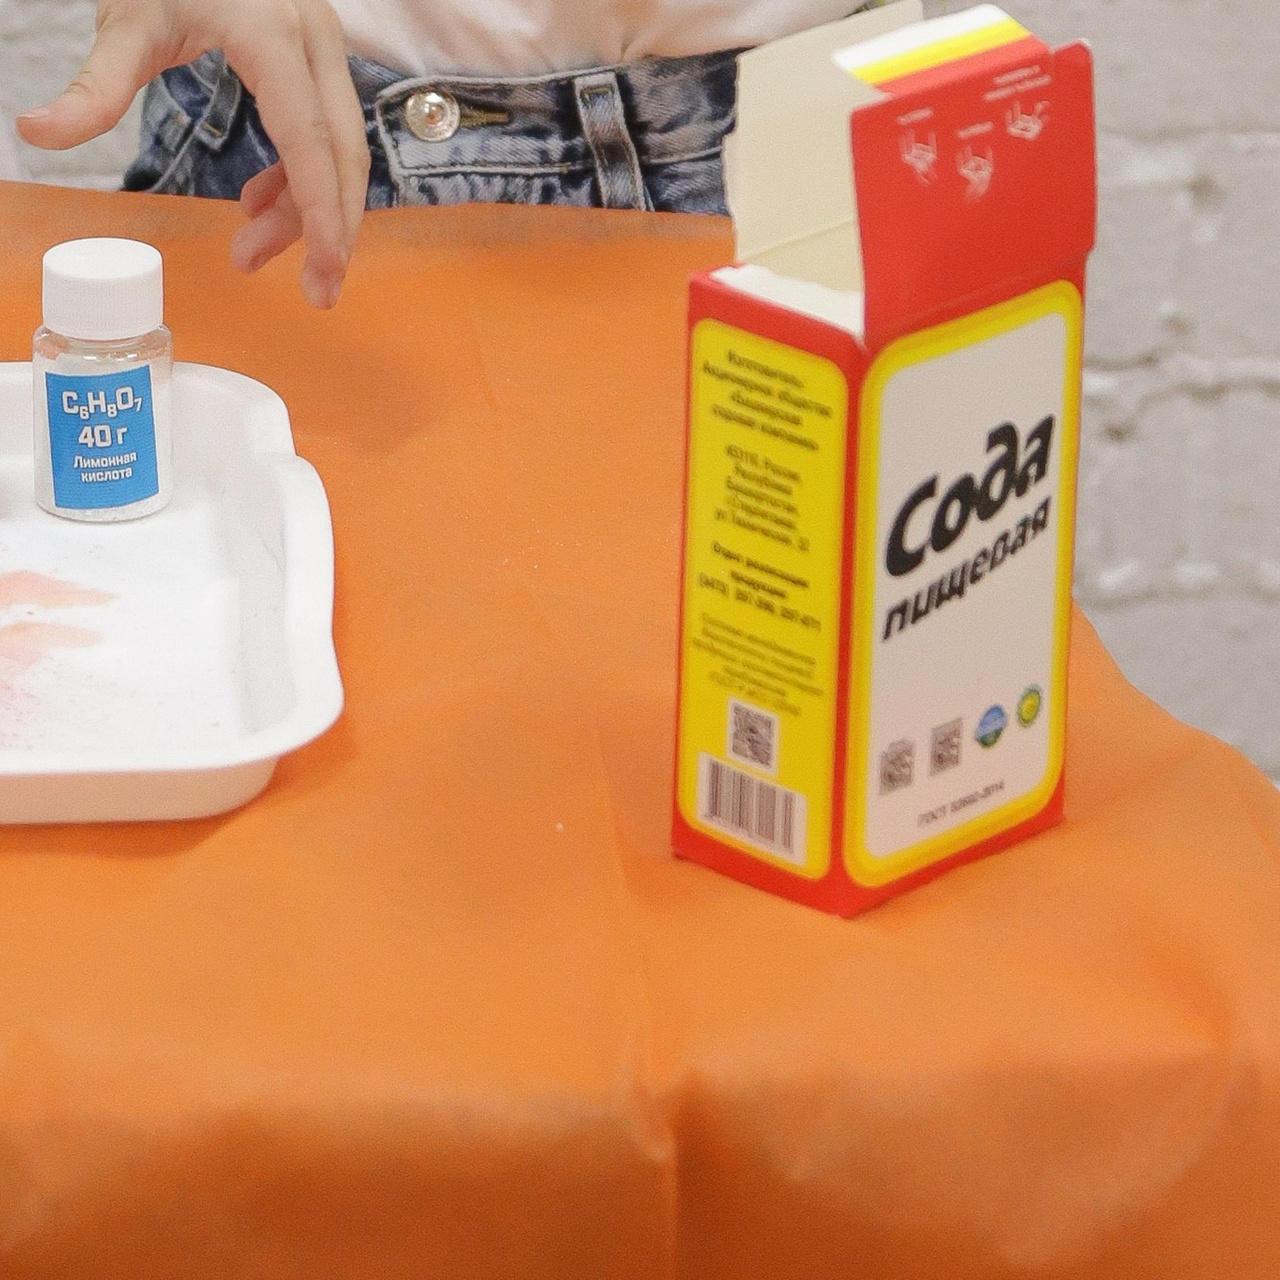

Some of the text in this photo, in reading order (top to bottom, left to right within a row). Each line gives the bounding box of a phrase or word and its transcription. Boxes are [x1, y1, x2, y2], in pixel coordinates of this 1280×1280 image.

[78, 424, 113, 448] 40
[73, 452, 138, 469] Лимонная
[81, 466, 133, 482] кислота
[885, 412, 1056, 577] Сода
[880, 495, 1052, 642] пищевая
